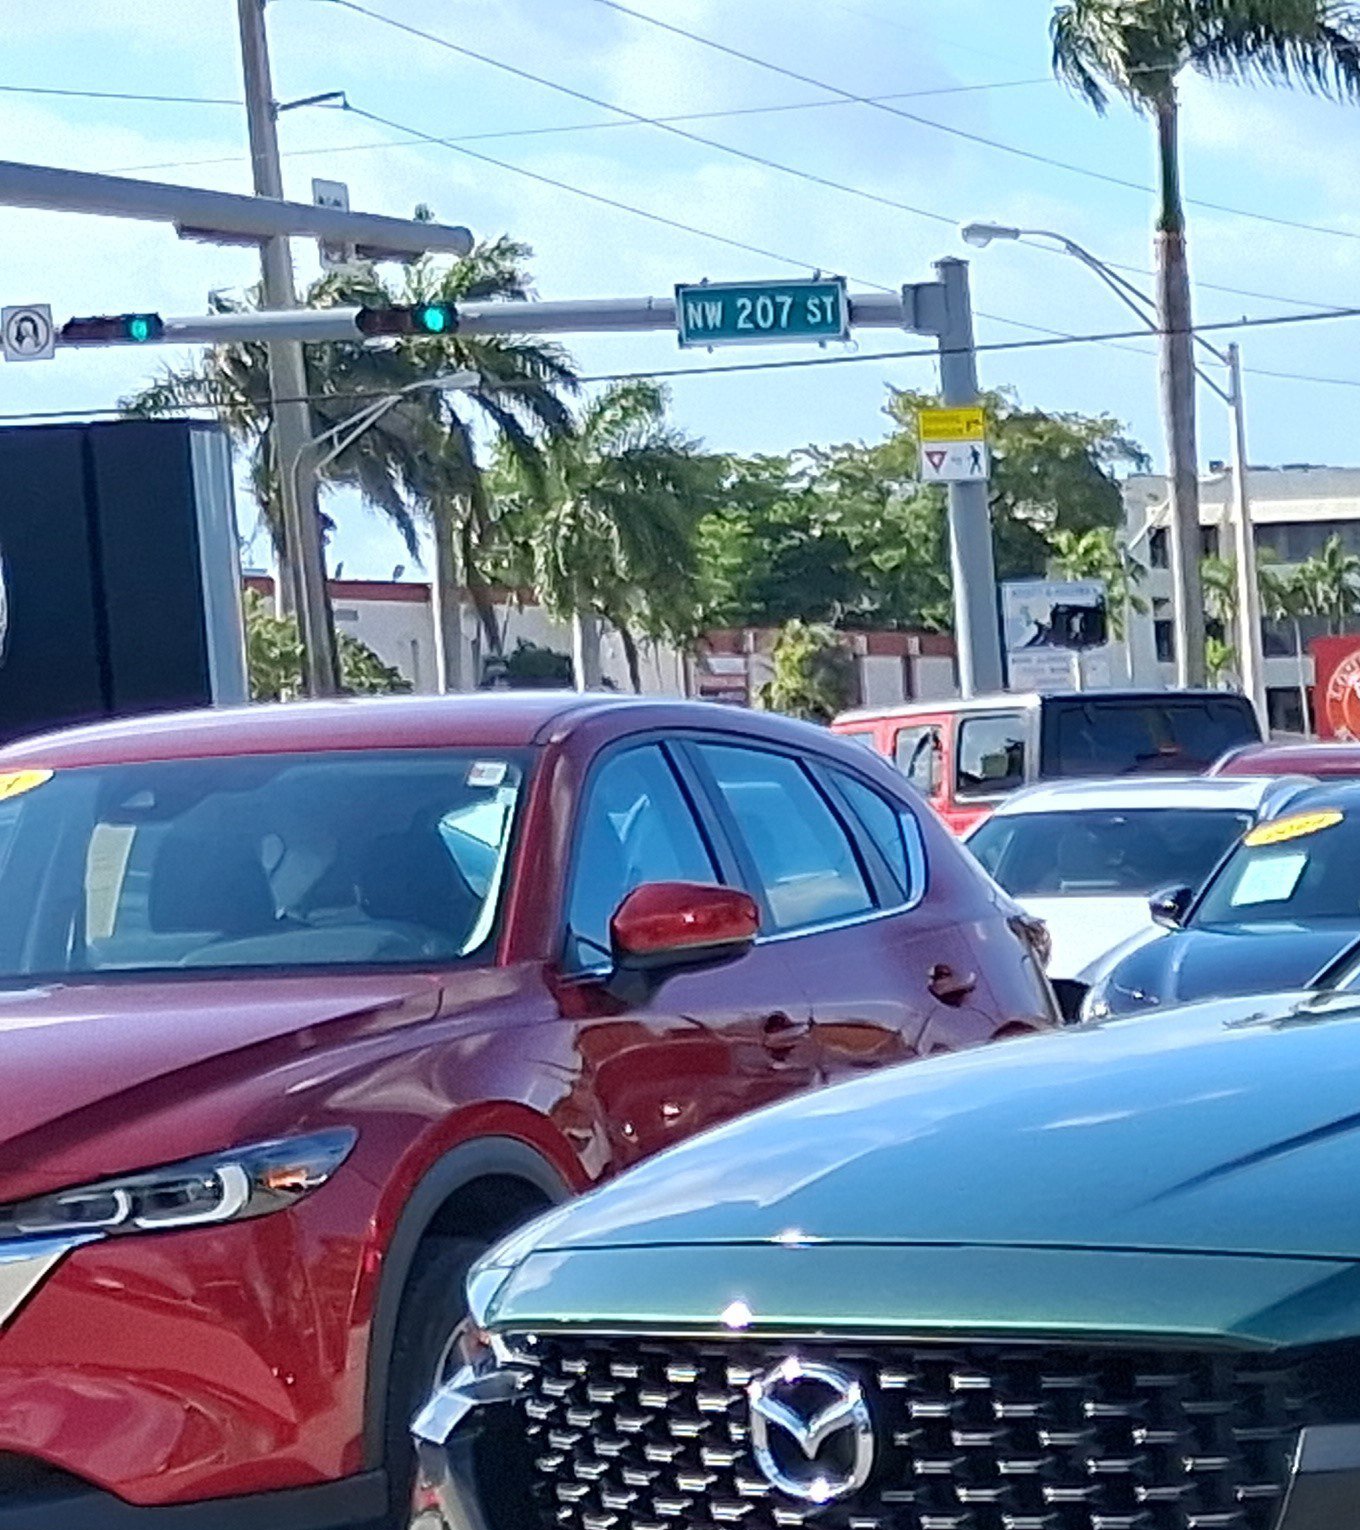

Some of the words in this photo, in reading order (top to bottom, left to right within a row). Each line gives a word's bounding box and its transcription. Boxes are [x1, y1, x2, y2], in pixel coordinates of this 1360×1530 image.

[686, 301, 723, 330] NW
[736, 295, 793, 329] 207
[806, 295, 834, 324] ST
